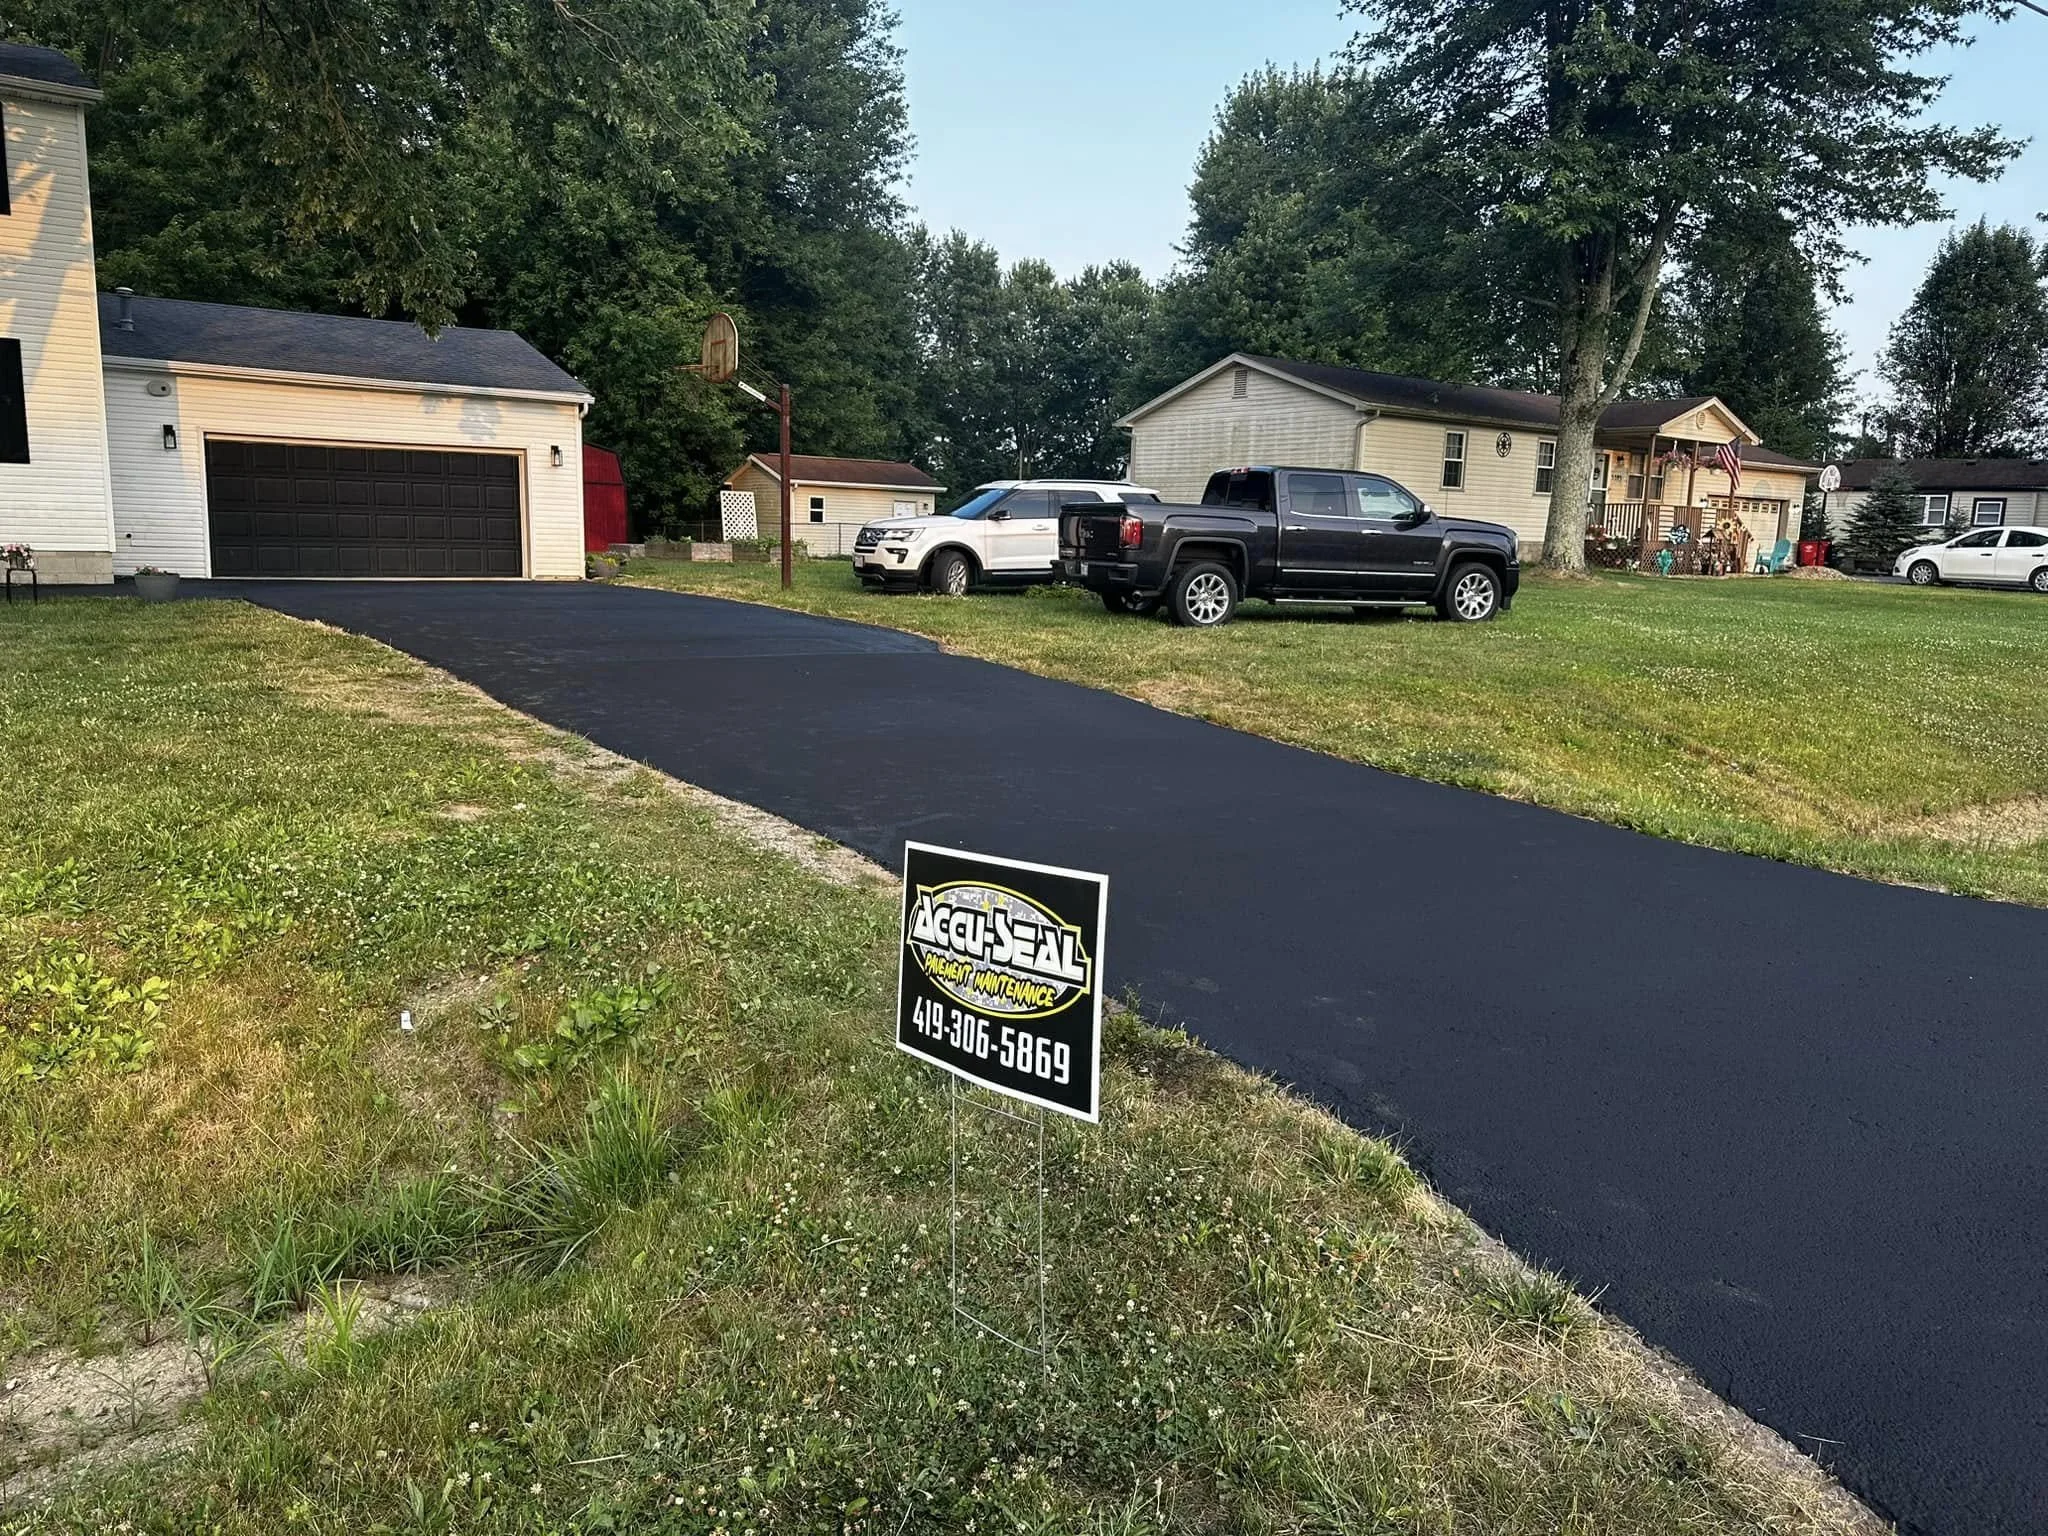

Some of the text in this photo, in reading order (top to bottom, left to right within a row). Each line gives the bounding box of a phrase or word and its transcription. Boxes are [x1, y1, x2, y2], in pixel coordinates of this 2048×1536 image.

[912, 895, 1084, 982] ACCU-SEAL
[925, 953, 1055, 1007] PAVEMENT MAINTENANCE
[912, 996, 1070, 1085] 419-306-5869
